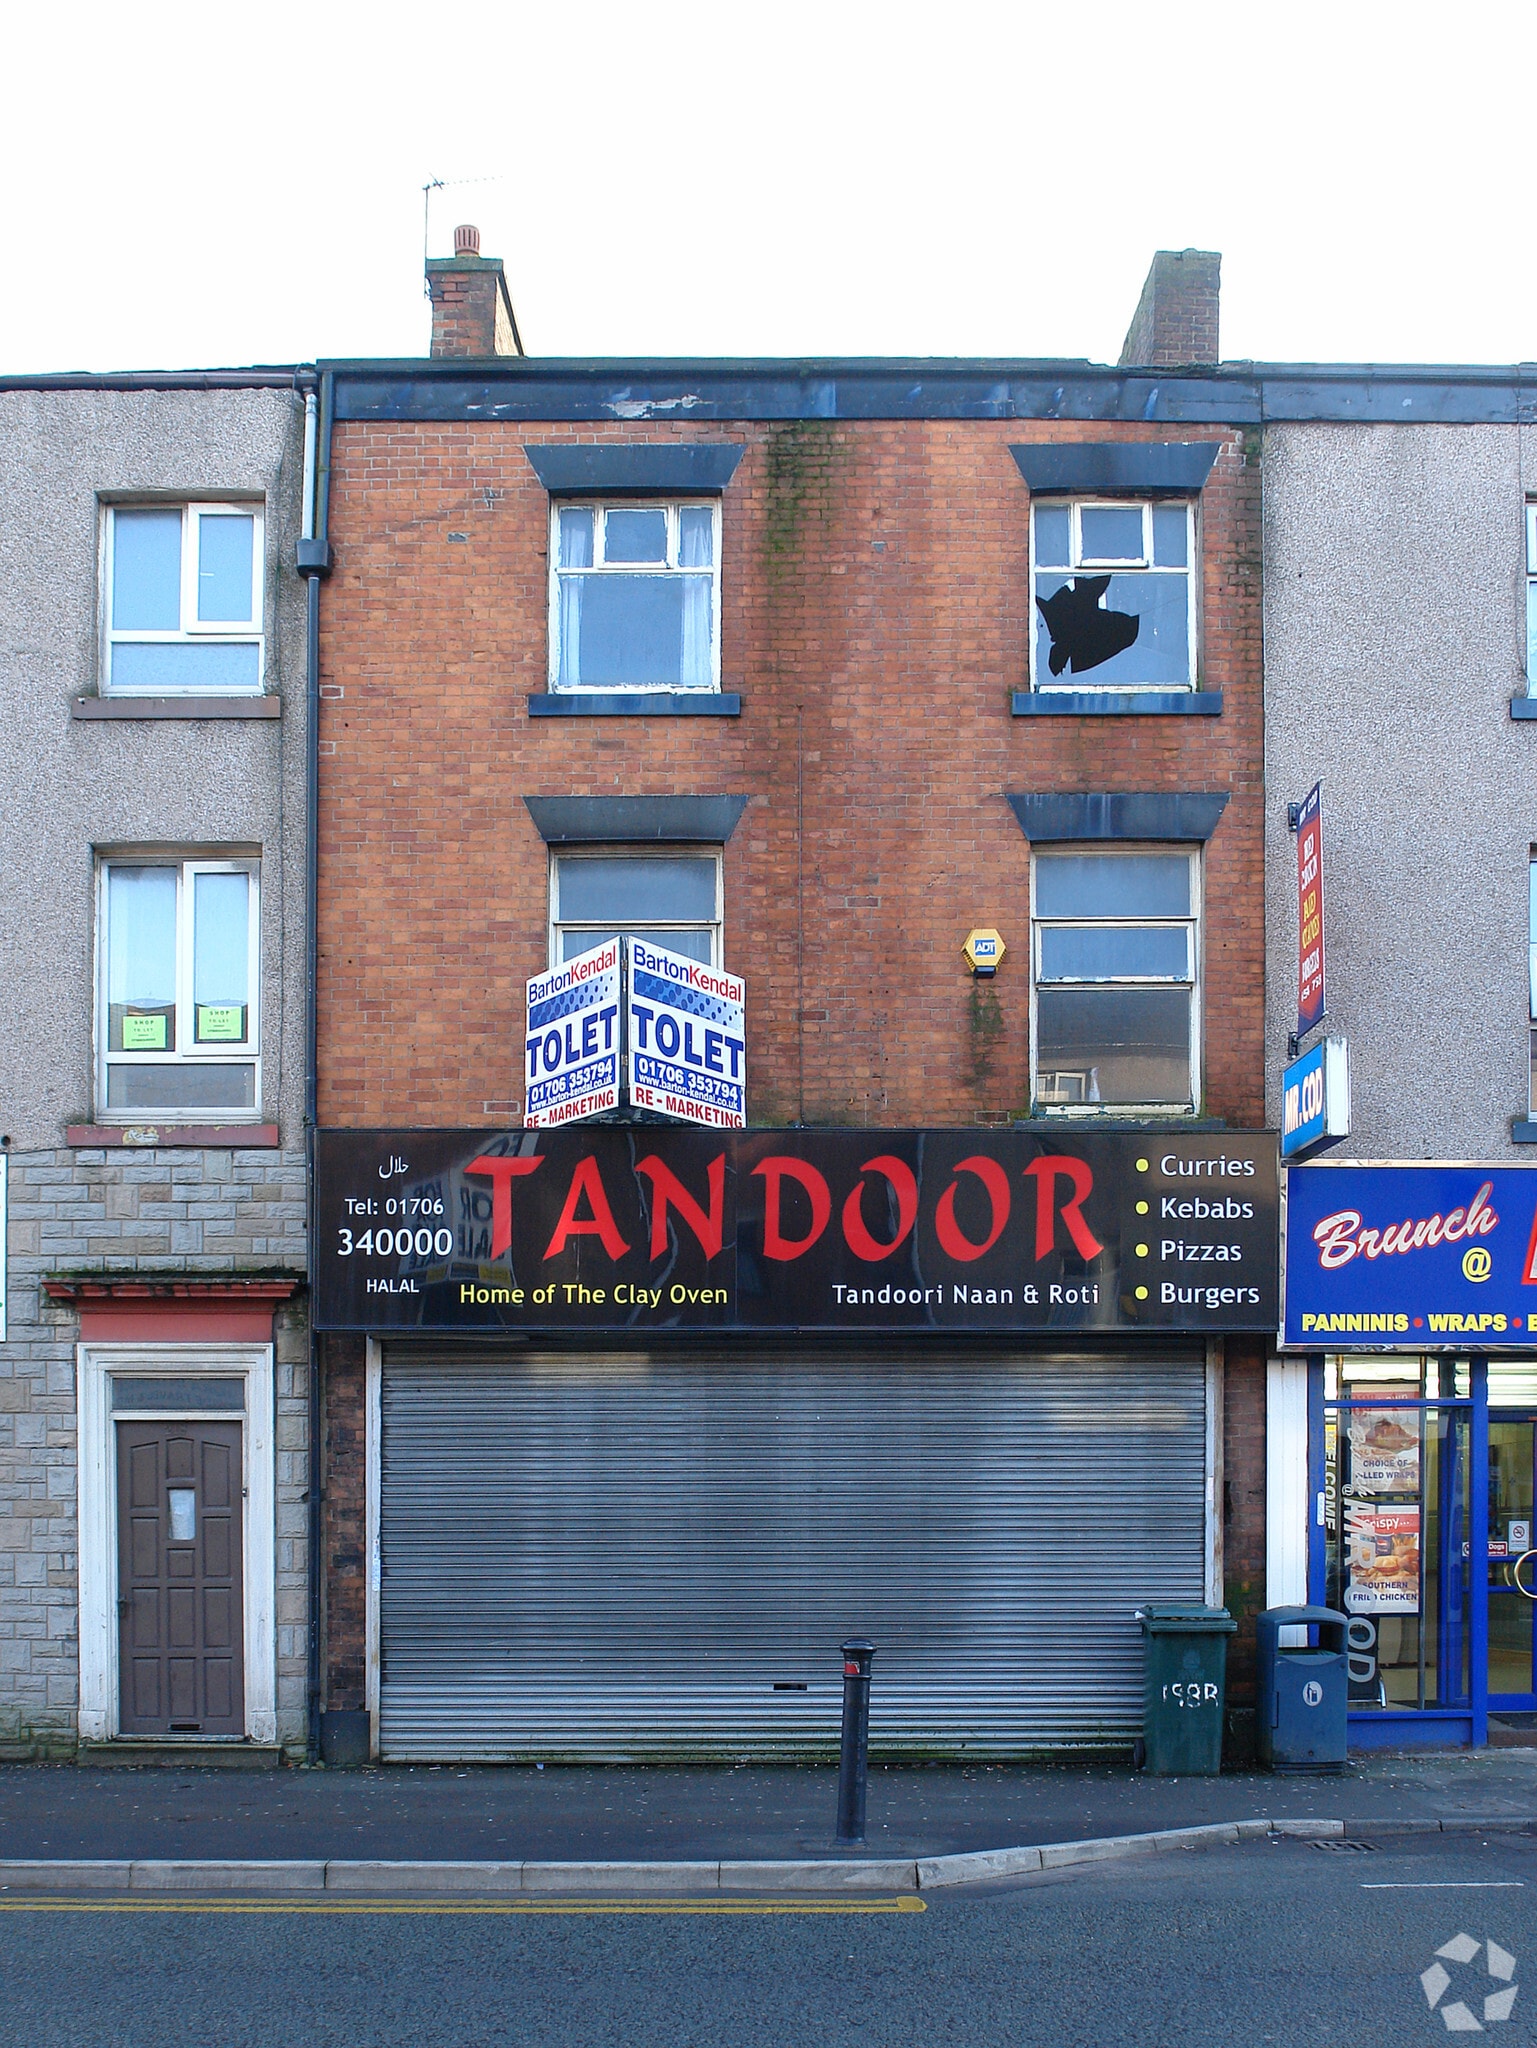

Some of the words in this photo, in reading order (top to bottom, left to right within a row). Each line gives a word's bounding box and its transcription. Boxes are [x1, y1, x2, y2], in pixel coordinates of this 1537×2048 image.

[975, 942, 995, 952] ADT
[529, 945, 616, 1004] BartonKendal
[634, 943, 742, 1003] BartonKendal
[530, 1075, 613, 1111] www.barton-kendal.co.uk
[531, 1082, 566, 1102] 01706
[569, 1063, 613, 1091] 353794
[638, 1058, 684, 1087] 01706
[687, 1072, 738, 1100] 353794
[638, 1075, 739, 1111] www.barton-kendal.co.uk
[549, 1089, 615, 1122] MARKETING
[665, 1094, 743, 1128] MARKETING
[1160, 1155, 1255, 1177] Curries
[345, 1198, 378, 1216] Tel:
[385, 1198, 444, 1216] 01706
[463, 1152, 1104, 1264] TANDOOR
[1160, 1197, 1254, 1220] Kebabs
[1312, 1181, 1499, 1268] Brunch
[337, 1228, 453, 1256] 340000
[1160, 1240, 1242, 1262] Pizzas
[1462, 1246, 1492, 1283] @
[366, 1278, 420, 1294] HALAL
[460, 1283, 524, 1304] Home
[532, 1283, 557, 1304] of
[562, 1283, 606, 1304] The
[614, 1283, 662, 1309] Clay
[669, 1284, 728, 1304] Oven
[832, 1283, 944, 1305] Tandoori
[953, 1284, 1013, 1305] Naan
[1022, 1284, 1039, 1304] &
[1049, 1284, 1099, 1305] Roti
[1160, 1282, 1260, 1309] Burgers
[1301, 1312, 1409, 1332] PANNINIS
[1427, 1312, 1508, 1332] WRAPS
[1380, 1593, 1417, 1601] CHICKEN
